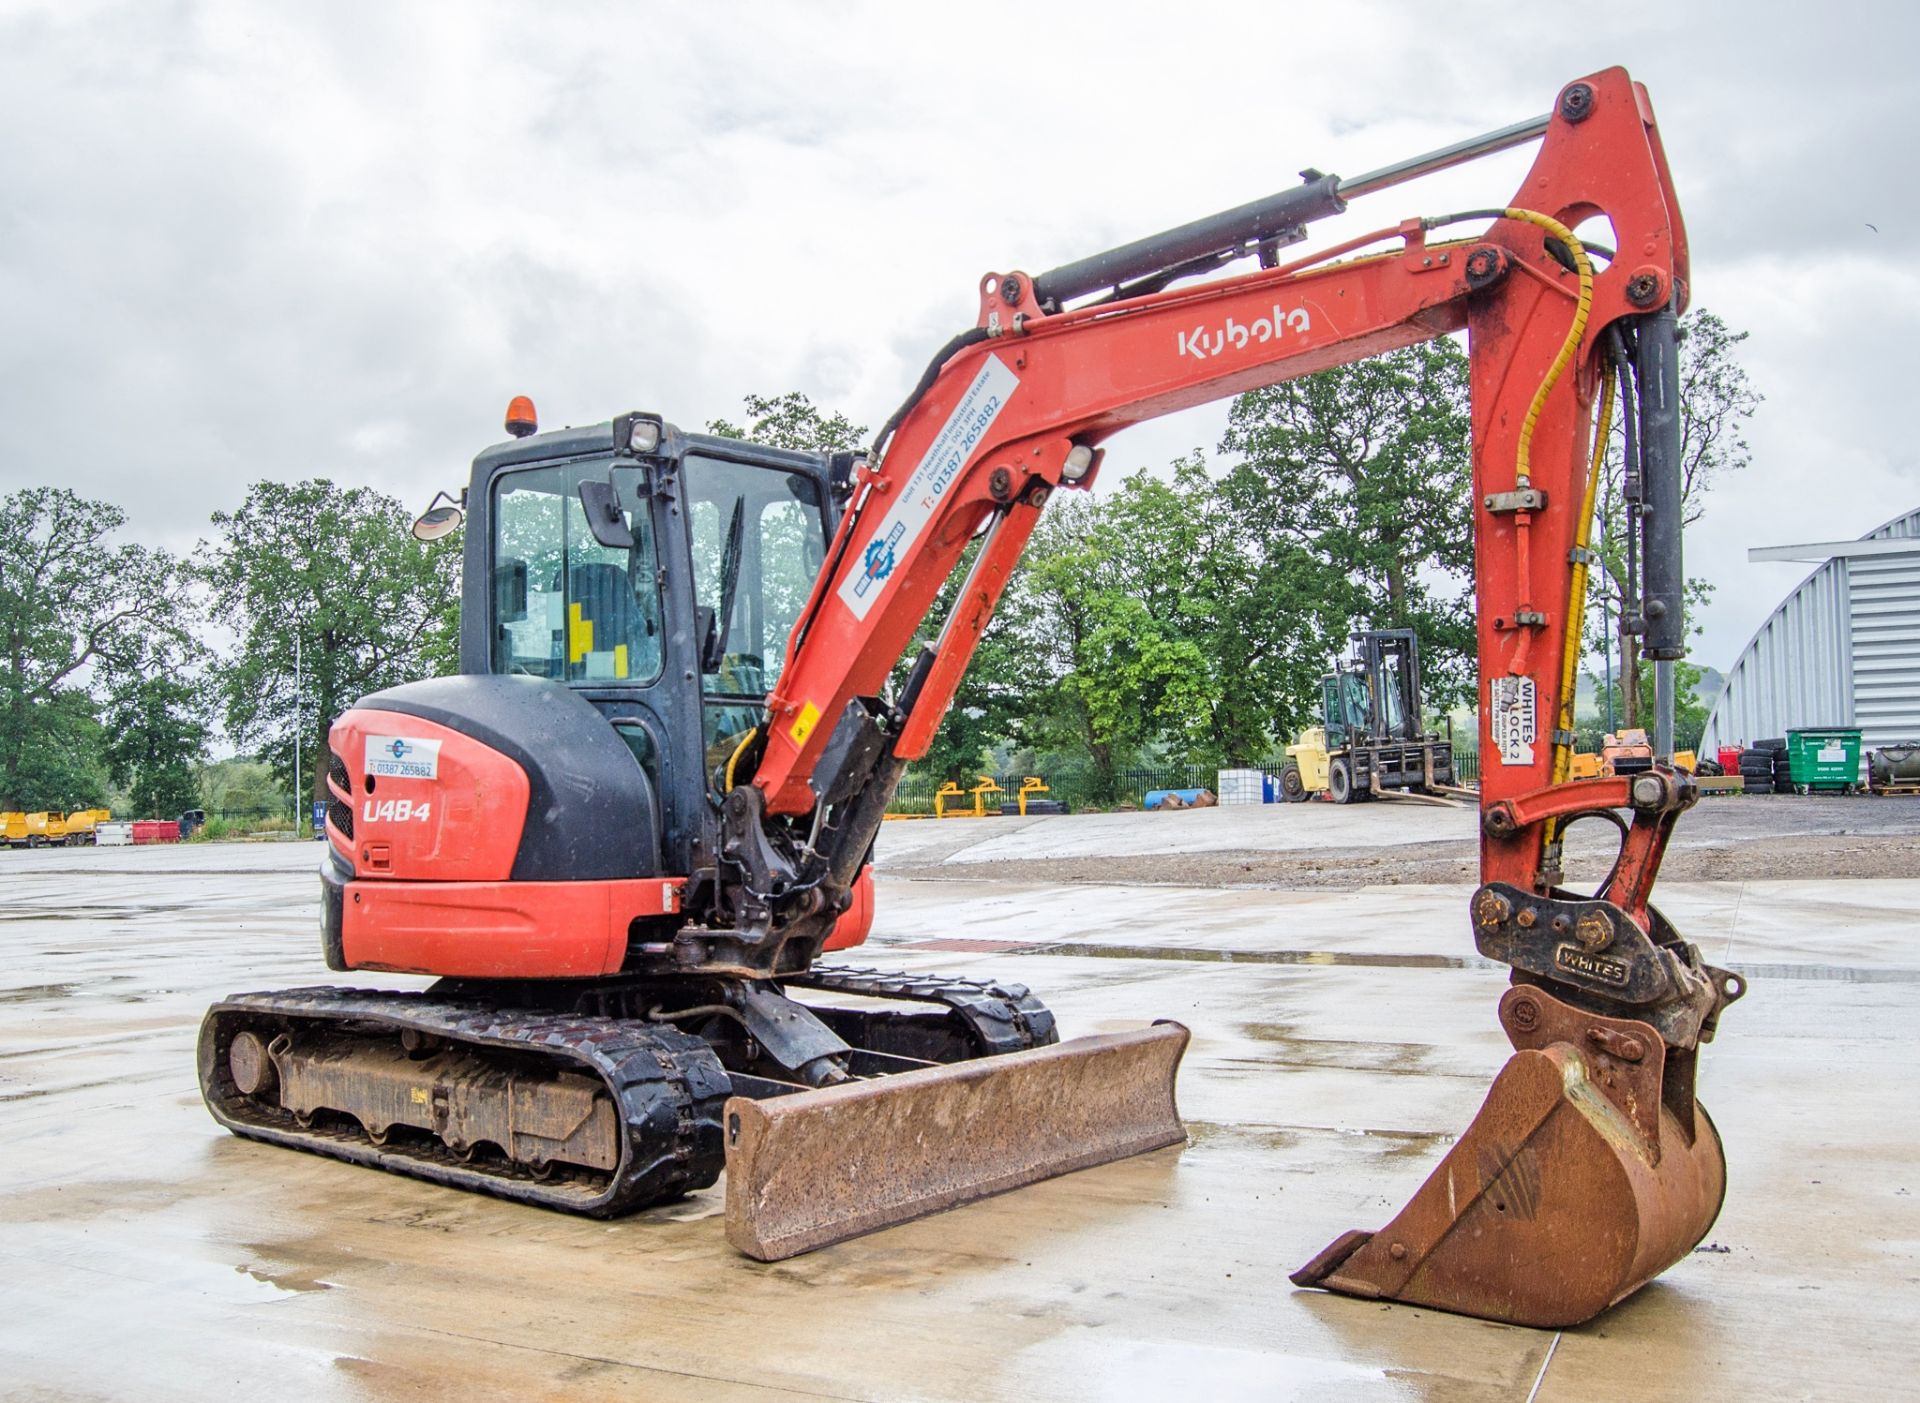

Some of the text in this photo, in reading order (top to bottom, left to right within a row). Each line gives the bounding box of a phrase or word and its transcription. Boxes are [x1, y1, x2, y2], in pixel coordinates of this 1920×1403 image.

[1178, 304, 1310, 359] Kubota
[902, 371, 991, 504] Unit 131 Heathhall Industrial Estate
[920, 395, 1001, 510] T: 01387 265882
[1522, 682, 1533, 743] WHITES
[377, 763, 399, 774] 01387
[400, 765, 431, 777] 265882
[1564, 951, 1623, 979] WHITES
